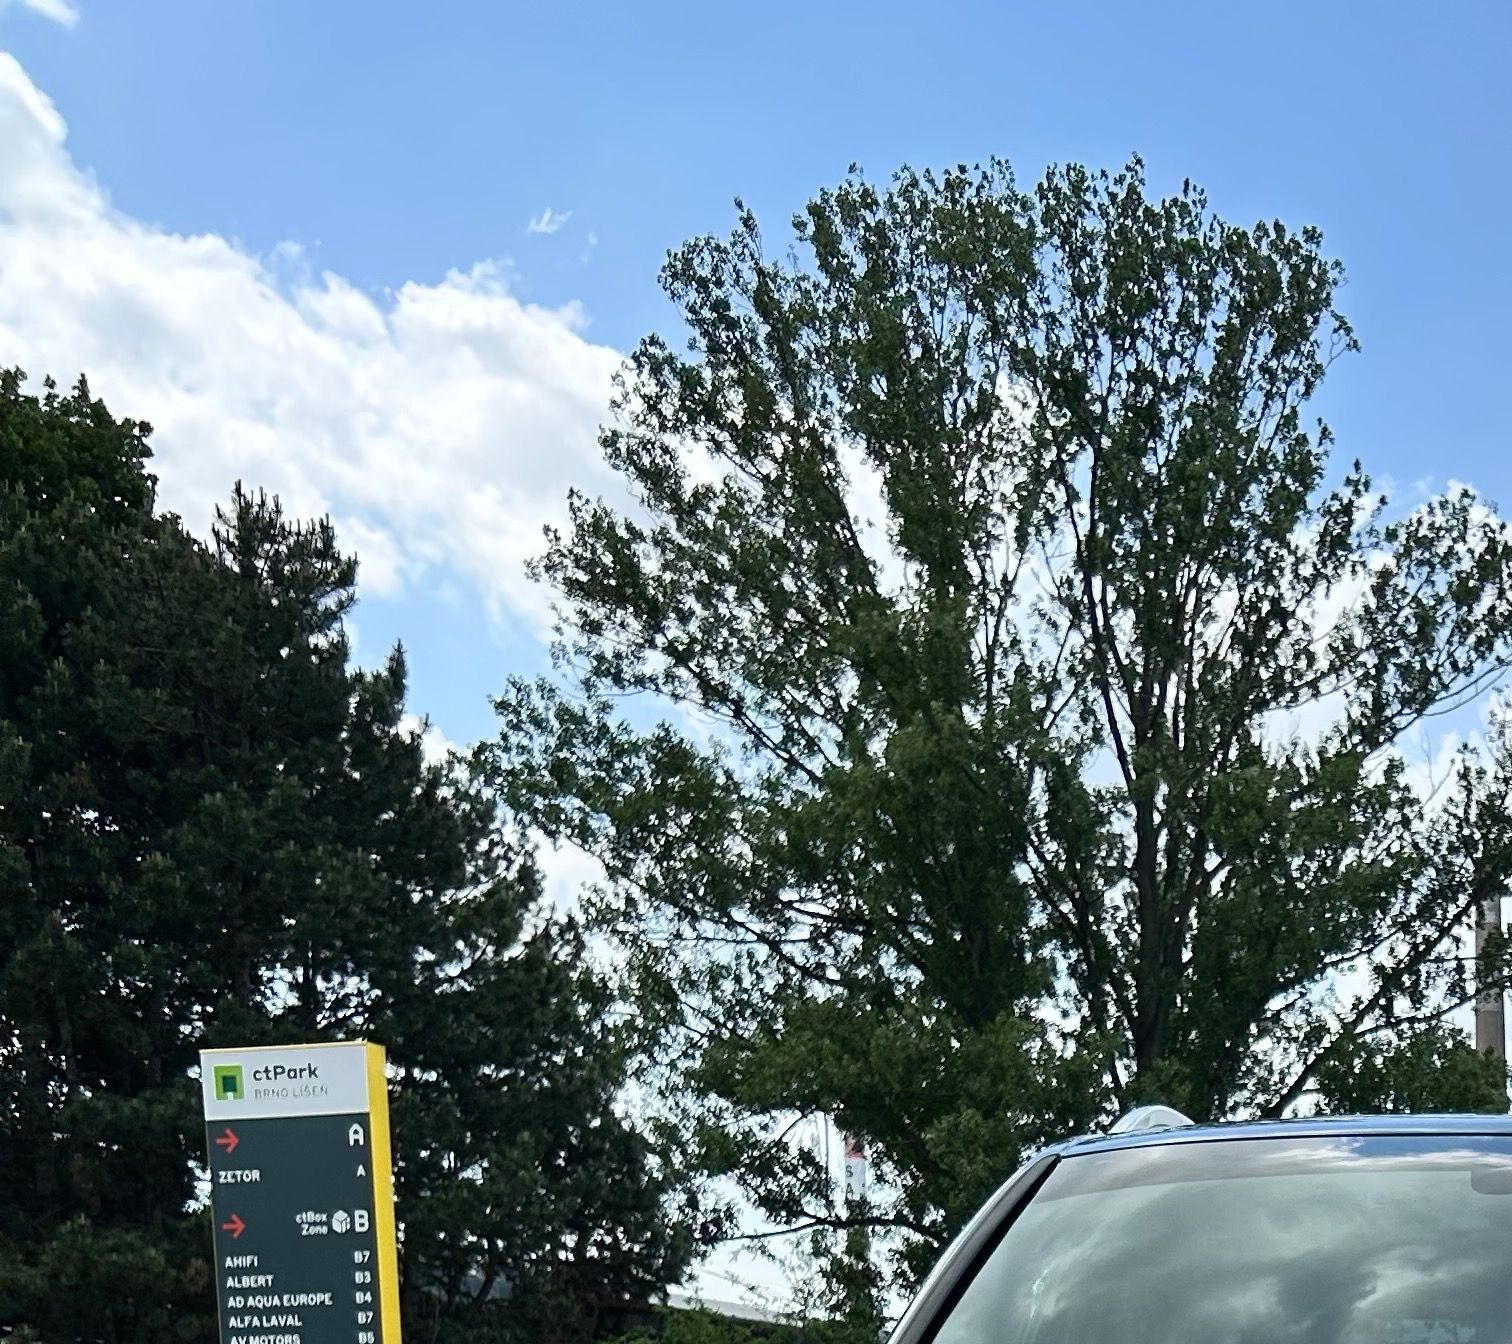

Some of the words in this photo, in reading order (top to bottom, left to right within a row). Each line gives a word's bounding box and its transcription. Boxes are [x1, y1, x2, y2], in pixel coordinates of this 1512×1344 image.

[253, 1063, 318, 1081] ctPark
[255, 1087, 288, 1099] BRNO
[349, 1123, 364, 1146] A
[218, 1169, 260, 1184] ZETOR
[356, 1164, 366, 1177] A
[296, 1211, 328, 1224] ctBox
[354, 1210, 369, 1232] B
[301, 1224, 328, 1236] Zone
[354, 1250, 370, 1264] B7
[226, 1274, 274, 1288] ALBERT
[355, 1270, 372, 1284] B3
[228, 1296, 244, 1308] AD
[247, 1295, 281, 1310] AQUA
[283, 1292, 333, 1307] EUROPE
[356, 1291, 372, 1304] B4
[229, 1316, 260, 1328] ALFA
[262, 1314, 302, 1328] LAVAL
[358, 1311, 374, 1324] B7
